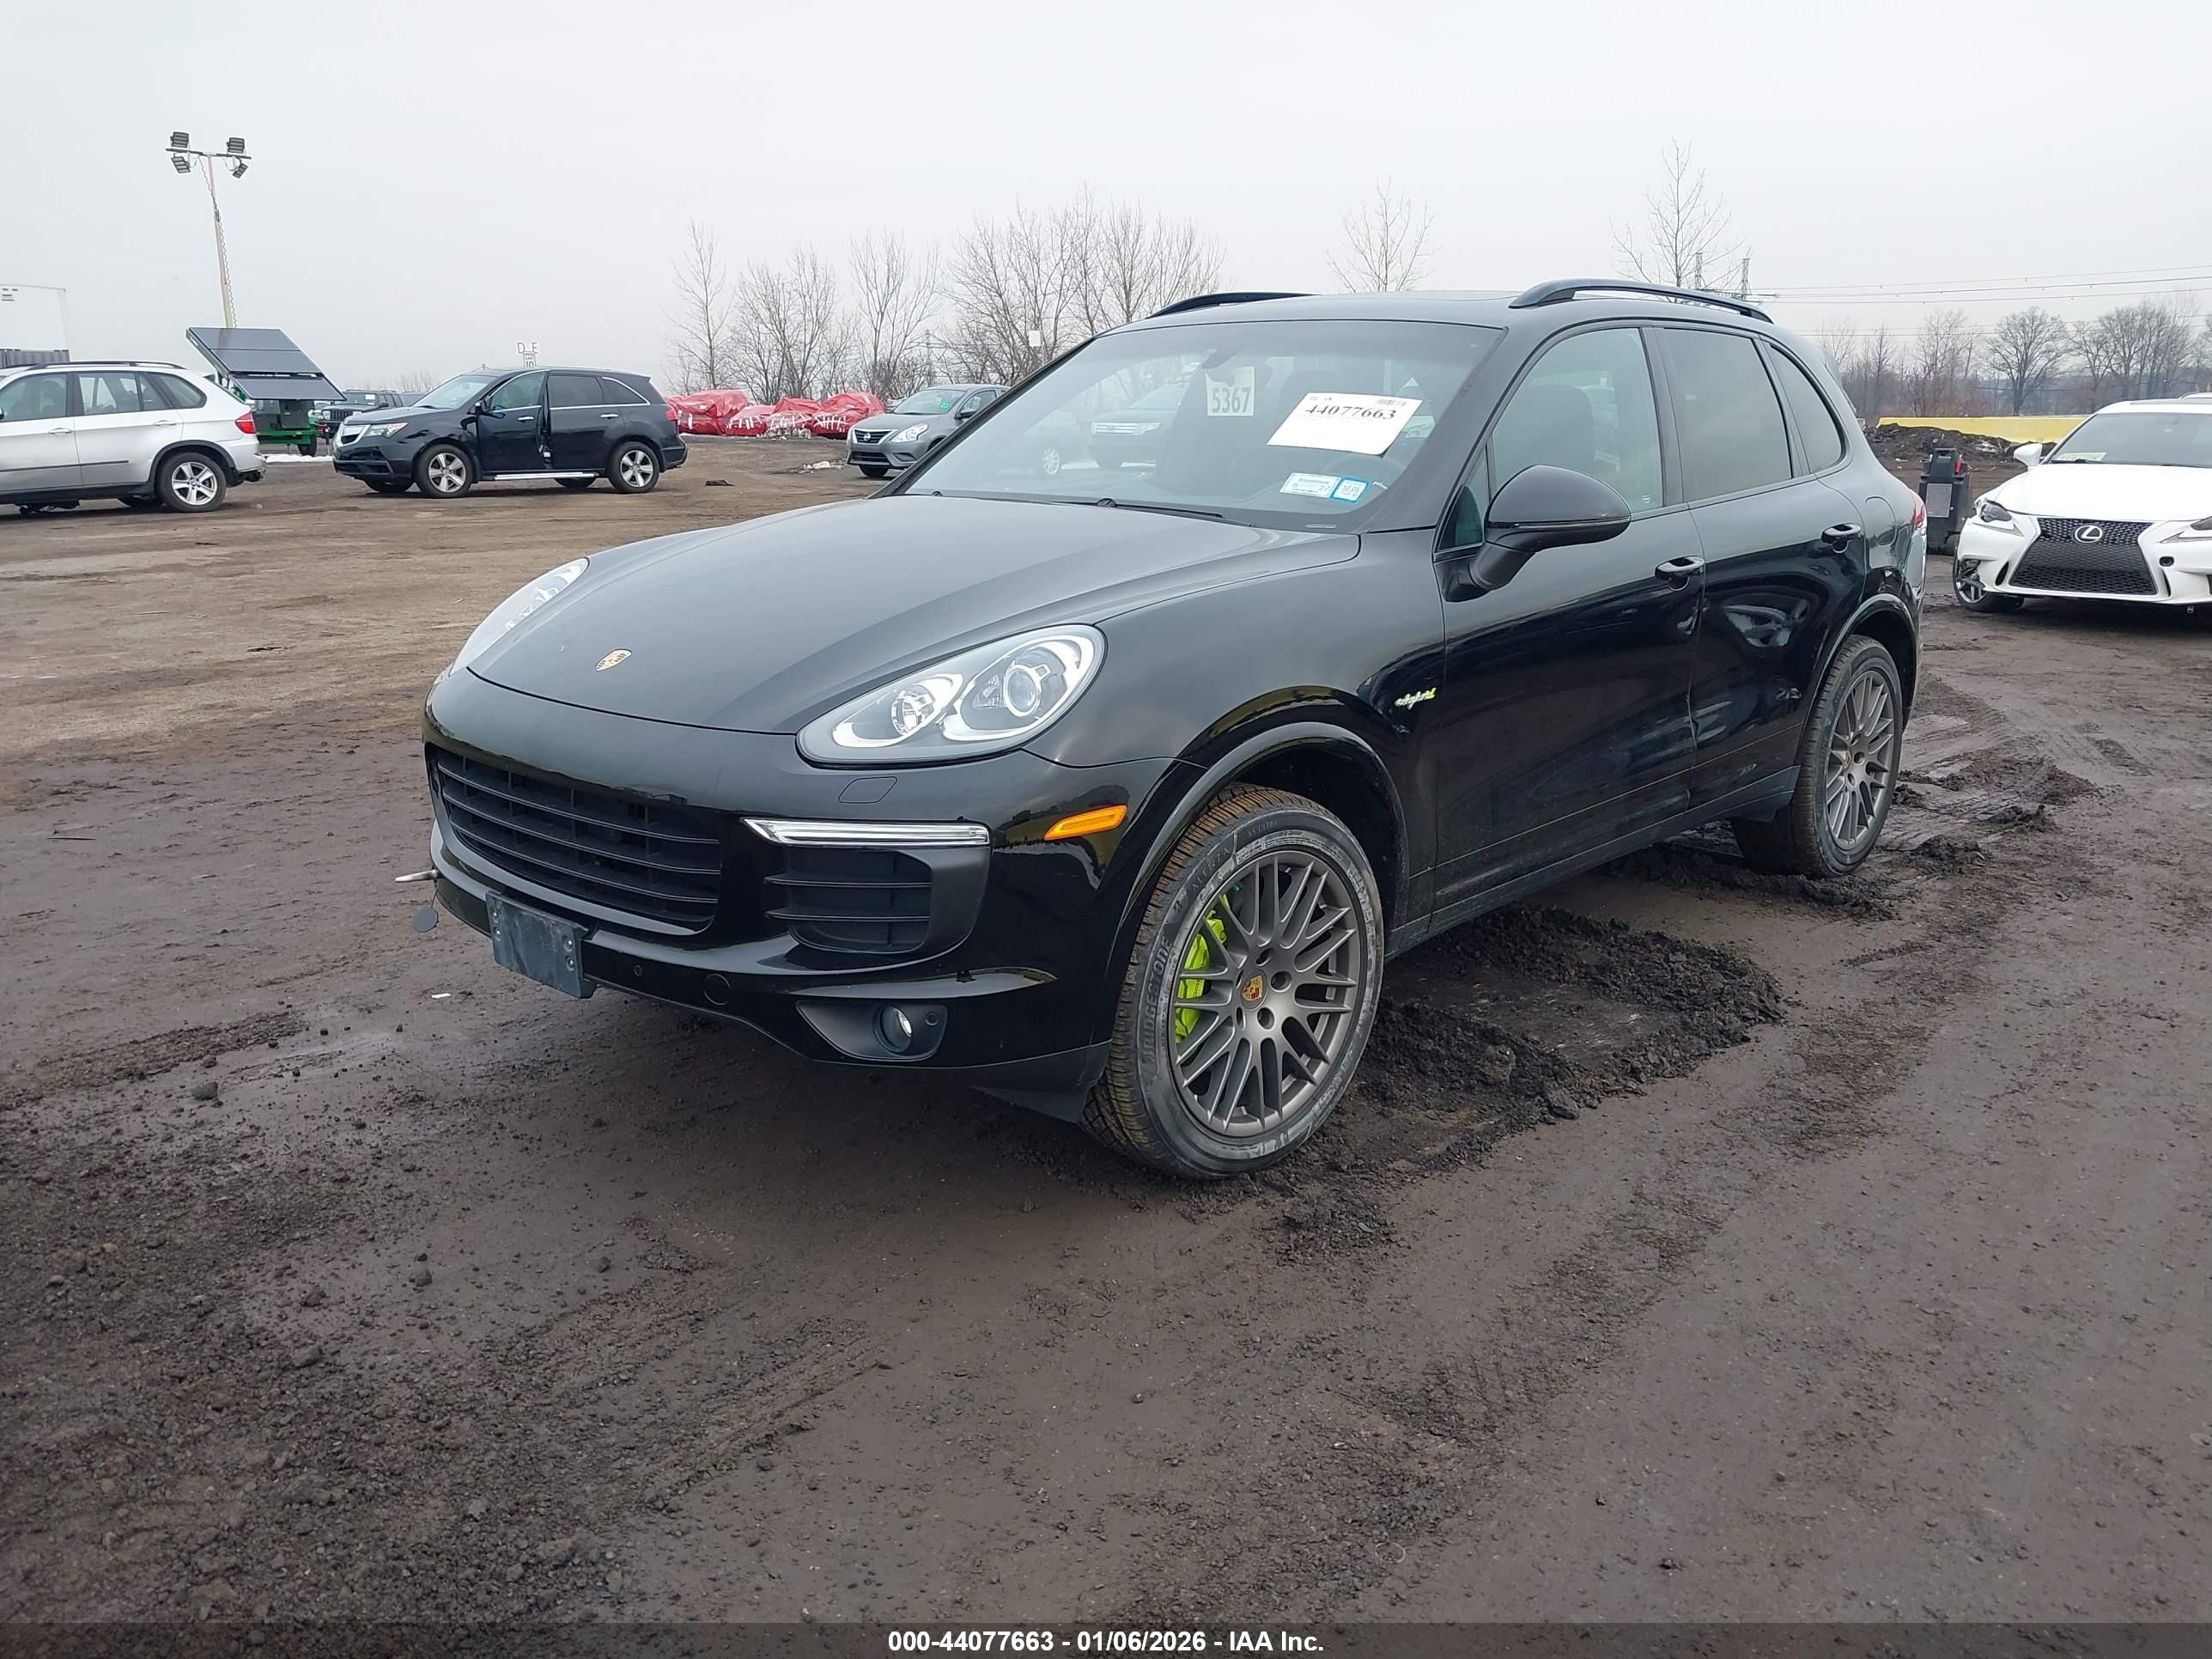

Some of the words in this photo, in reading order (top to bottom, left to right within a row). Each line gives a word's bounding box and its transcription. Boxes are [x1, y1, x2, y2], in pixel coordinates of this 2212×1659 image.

[1212, 387, 1251, 413] 5367
[1305, 404, 1397, 420] 44077663
[1142, 934, 1174, 1066] BRIDGESTONE
